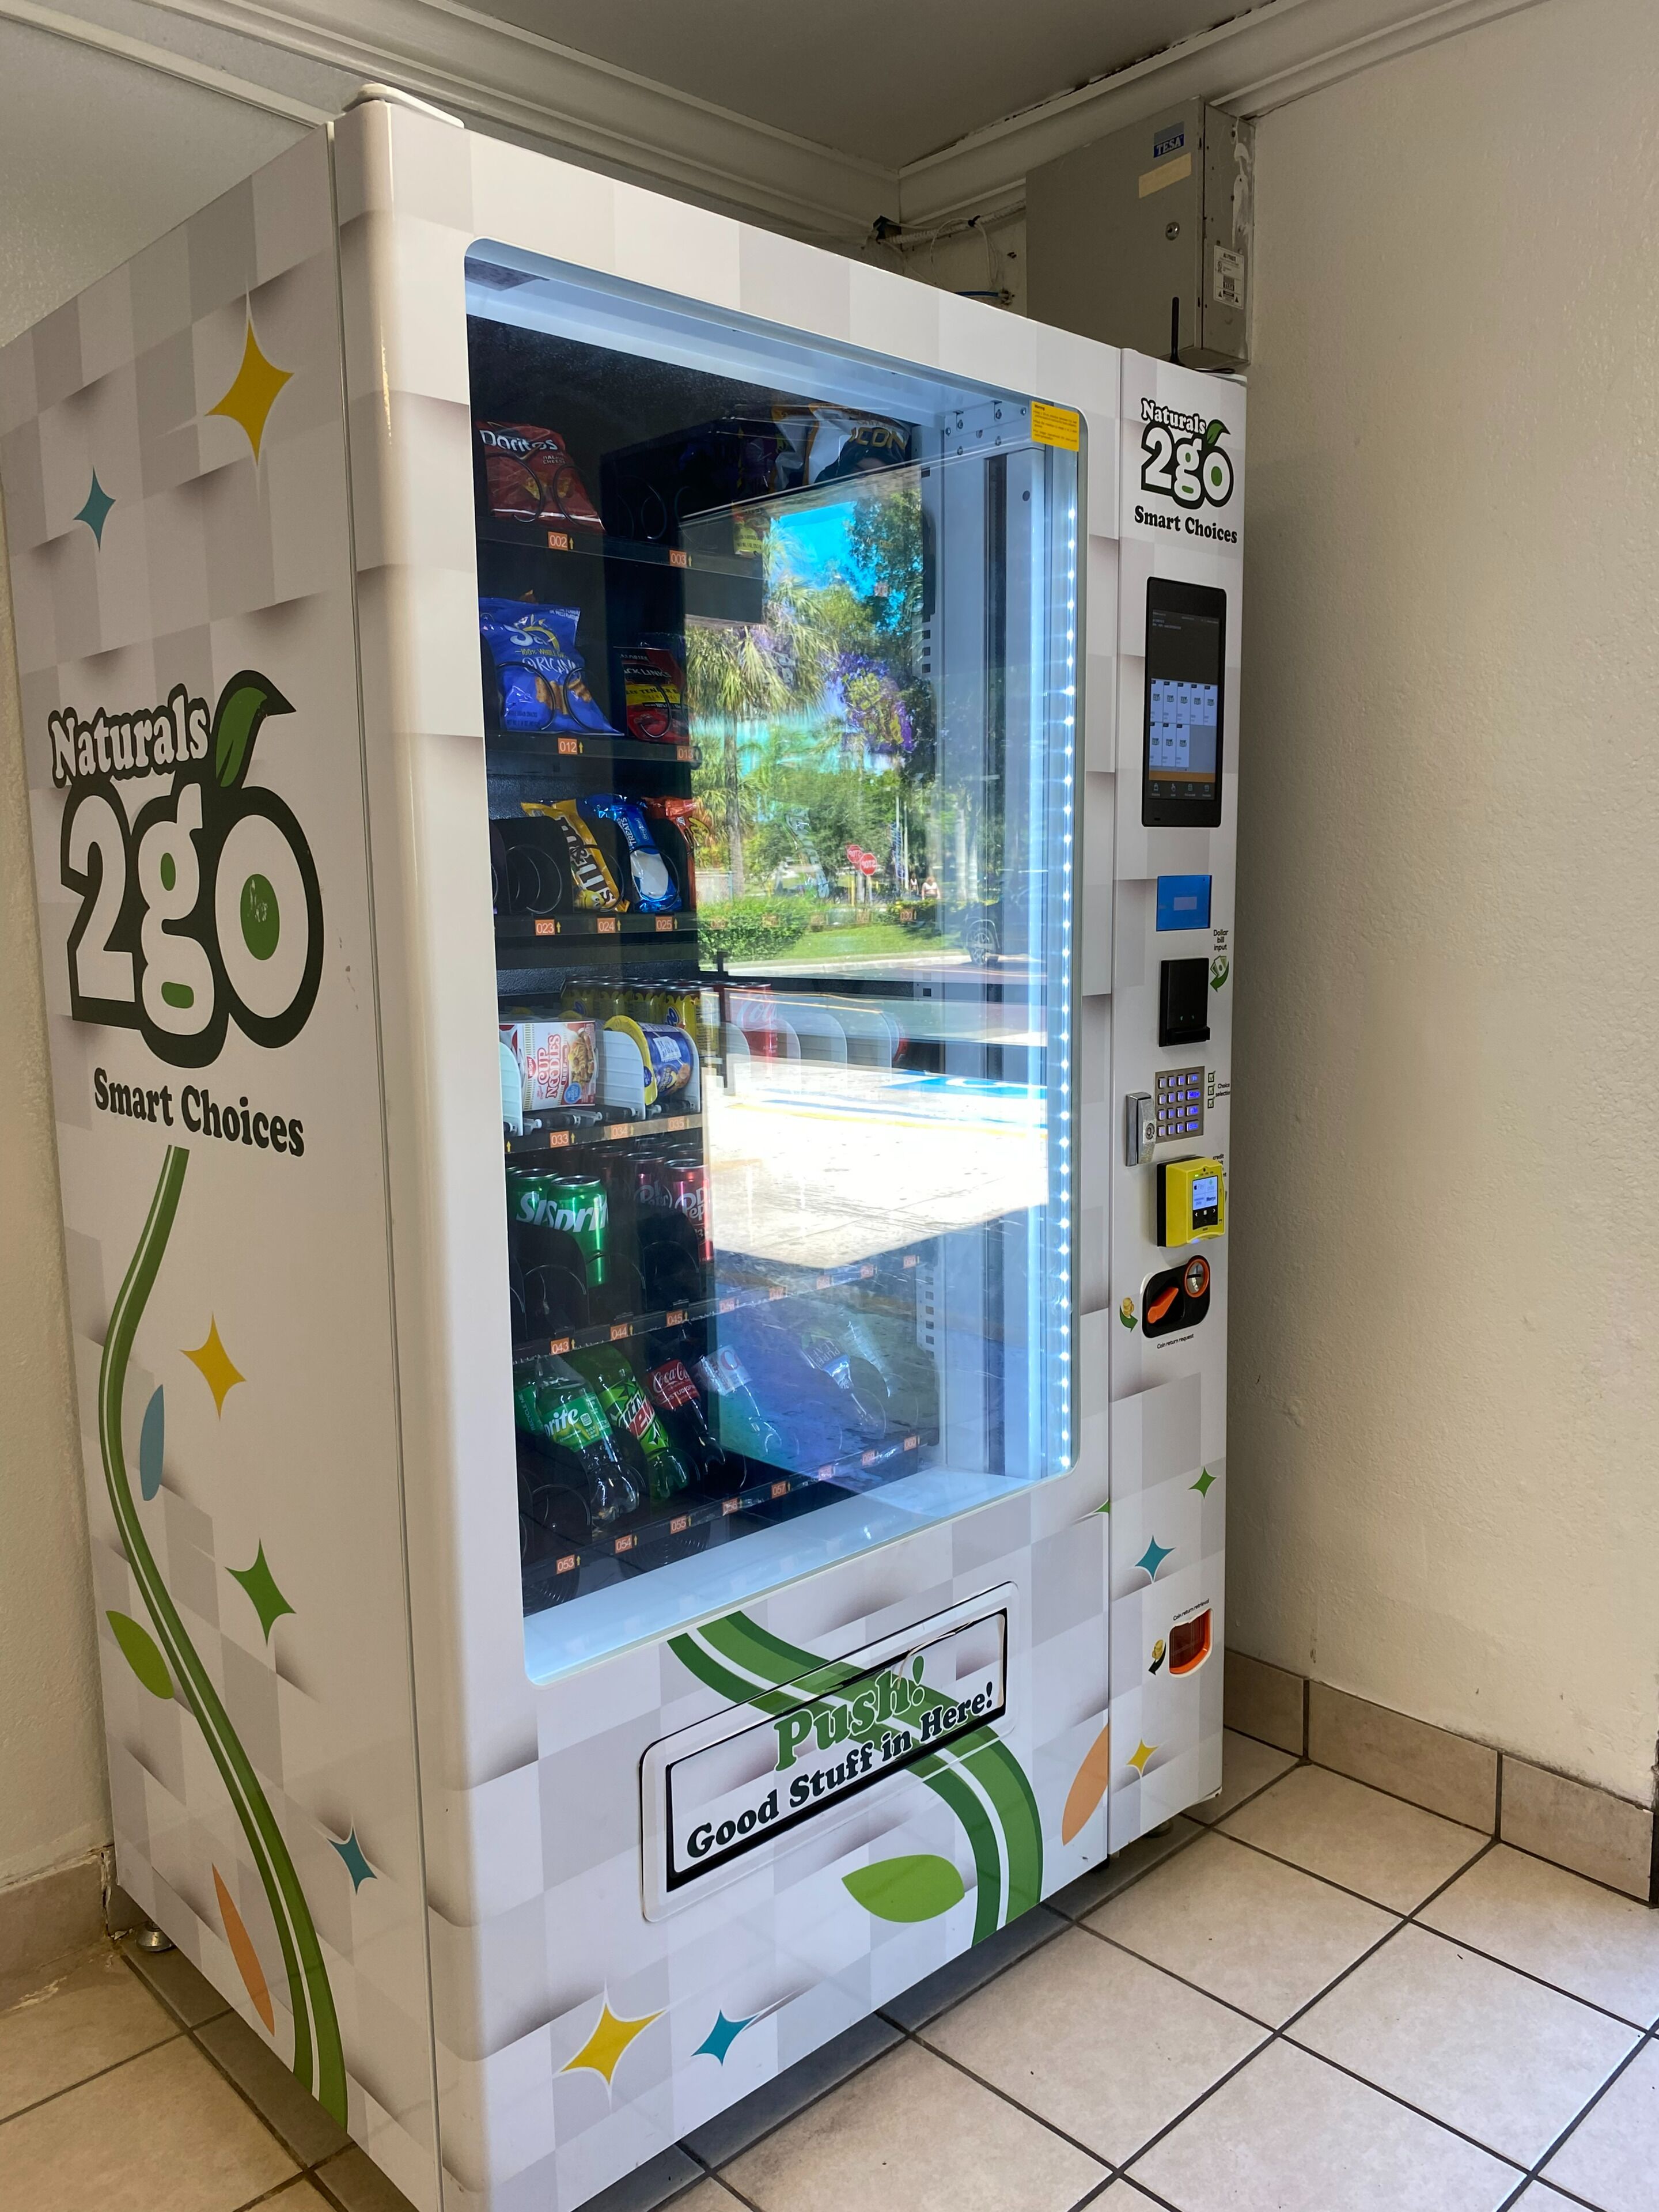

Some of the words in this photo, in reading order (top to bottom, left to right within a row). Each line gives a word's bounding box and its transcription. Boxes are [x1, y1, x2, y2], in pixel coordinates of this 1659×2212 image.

[1156, 137, 1181, 156] TESA
[1141, 397, 1207, 435] Naturals
[479, 430, 558, 452] Doritos
[1141, 421, 1234, 510] 2go
[1134, 505, 1181, 532] Smart
[1185, 516, 1238, 544] Choices
[550, 536, 567, 548] 002
[671, 553, 687, 565] 003
[49, 683, 210, 789] Naturals
[559, 741, 577, 752] 012
[678, 749, 693, 759] 013
[622, 817, 637, 844] TREATS
[60, 772, 324, 1069] 2go
[599, 922, 615, 931] 024
[656, 920, 672, 930] 025
[537, 924, 554, 934] 023
[1214, 944, 1228, 952] input
[537, 1047, 550, 1085] CUP
[546, 1034, 561, 1099] NOODLES
[94, 1067, 173, 1126] Smart
[181, 1085, 305, 1158] Choices
[669, 1120, 684, 1129] 035
[613, 1127, 628, 1136] 034
[551, 1135, 569, 1145] 033
[668, 1315, 683, 1324] 045
[612, 1327, 627, 1337] 044
[552, 1342, 569, 1352] 043
[1166, 1339, 1178, 1347] return
[1179, 1334, 1194, 1342] request
[518, 1392, 525, 1405] ME
[524, 1404, 536, 1431] RECYCLE
[772, 1484, 786, 1495] 057
[671, 1518, 687, 1531] 055
[616, 1539, 632, 1550] 054
[558, 1559, 574, 1571] 053
[1182, 1608, 1194, 1617] return
[1194, 1599, 1209, 1609] retrieval
[774, 1654, 926, 1772] Push!
[687, 1789, 778, 1859] Good
[789, 1744, 874, 1808] Stuff
[882, 1730, 912, 1762] in
[919, 1681, 994, 1741] Here!
